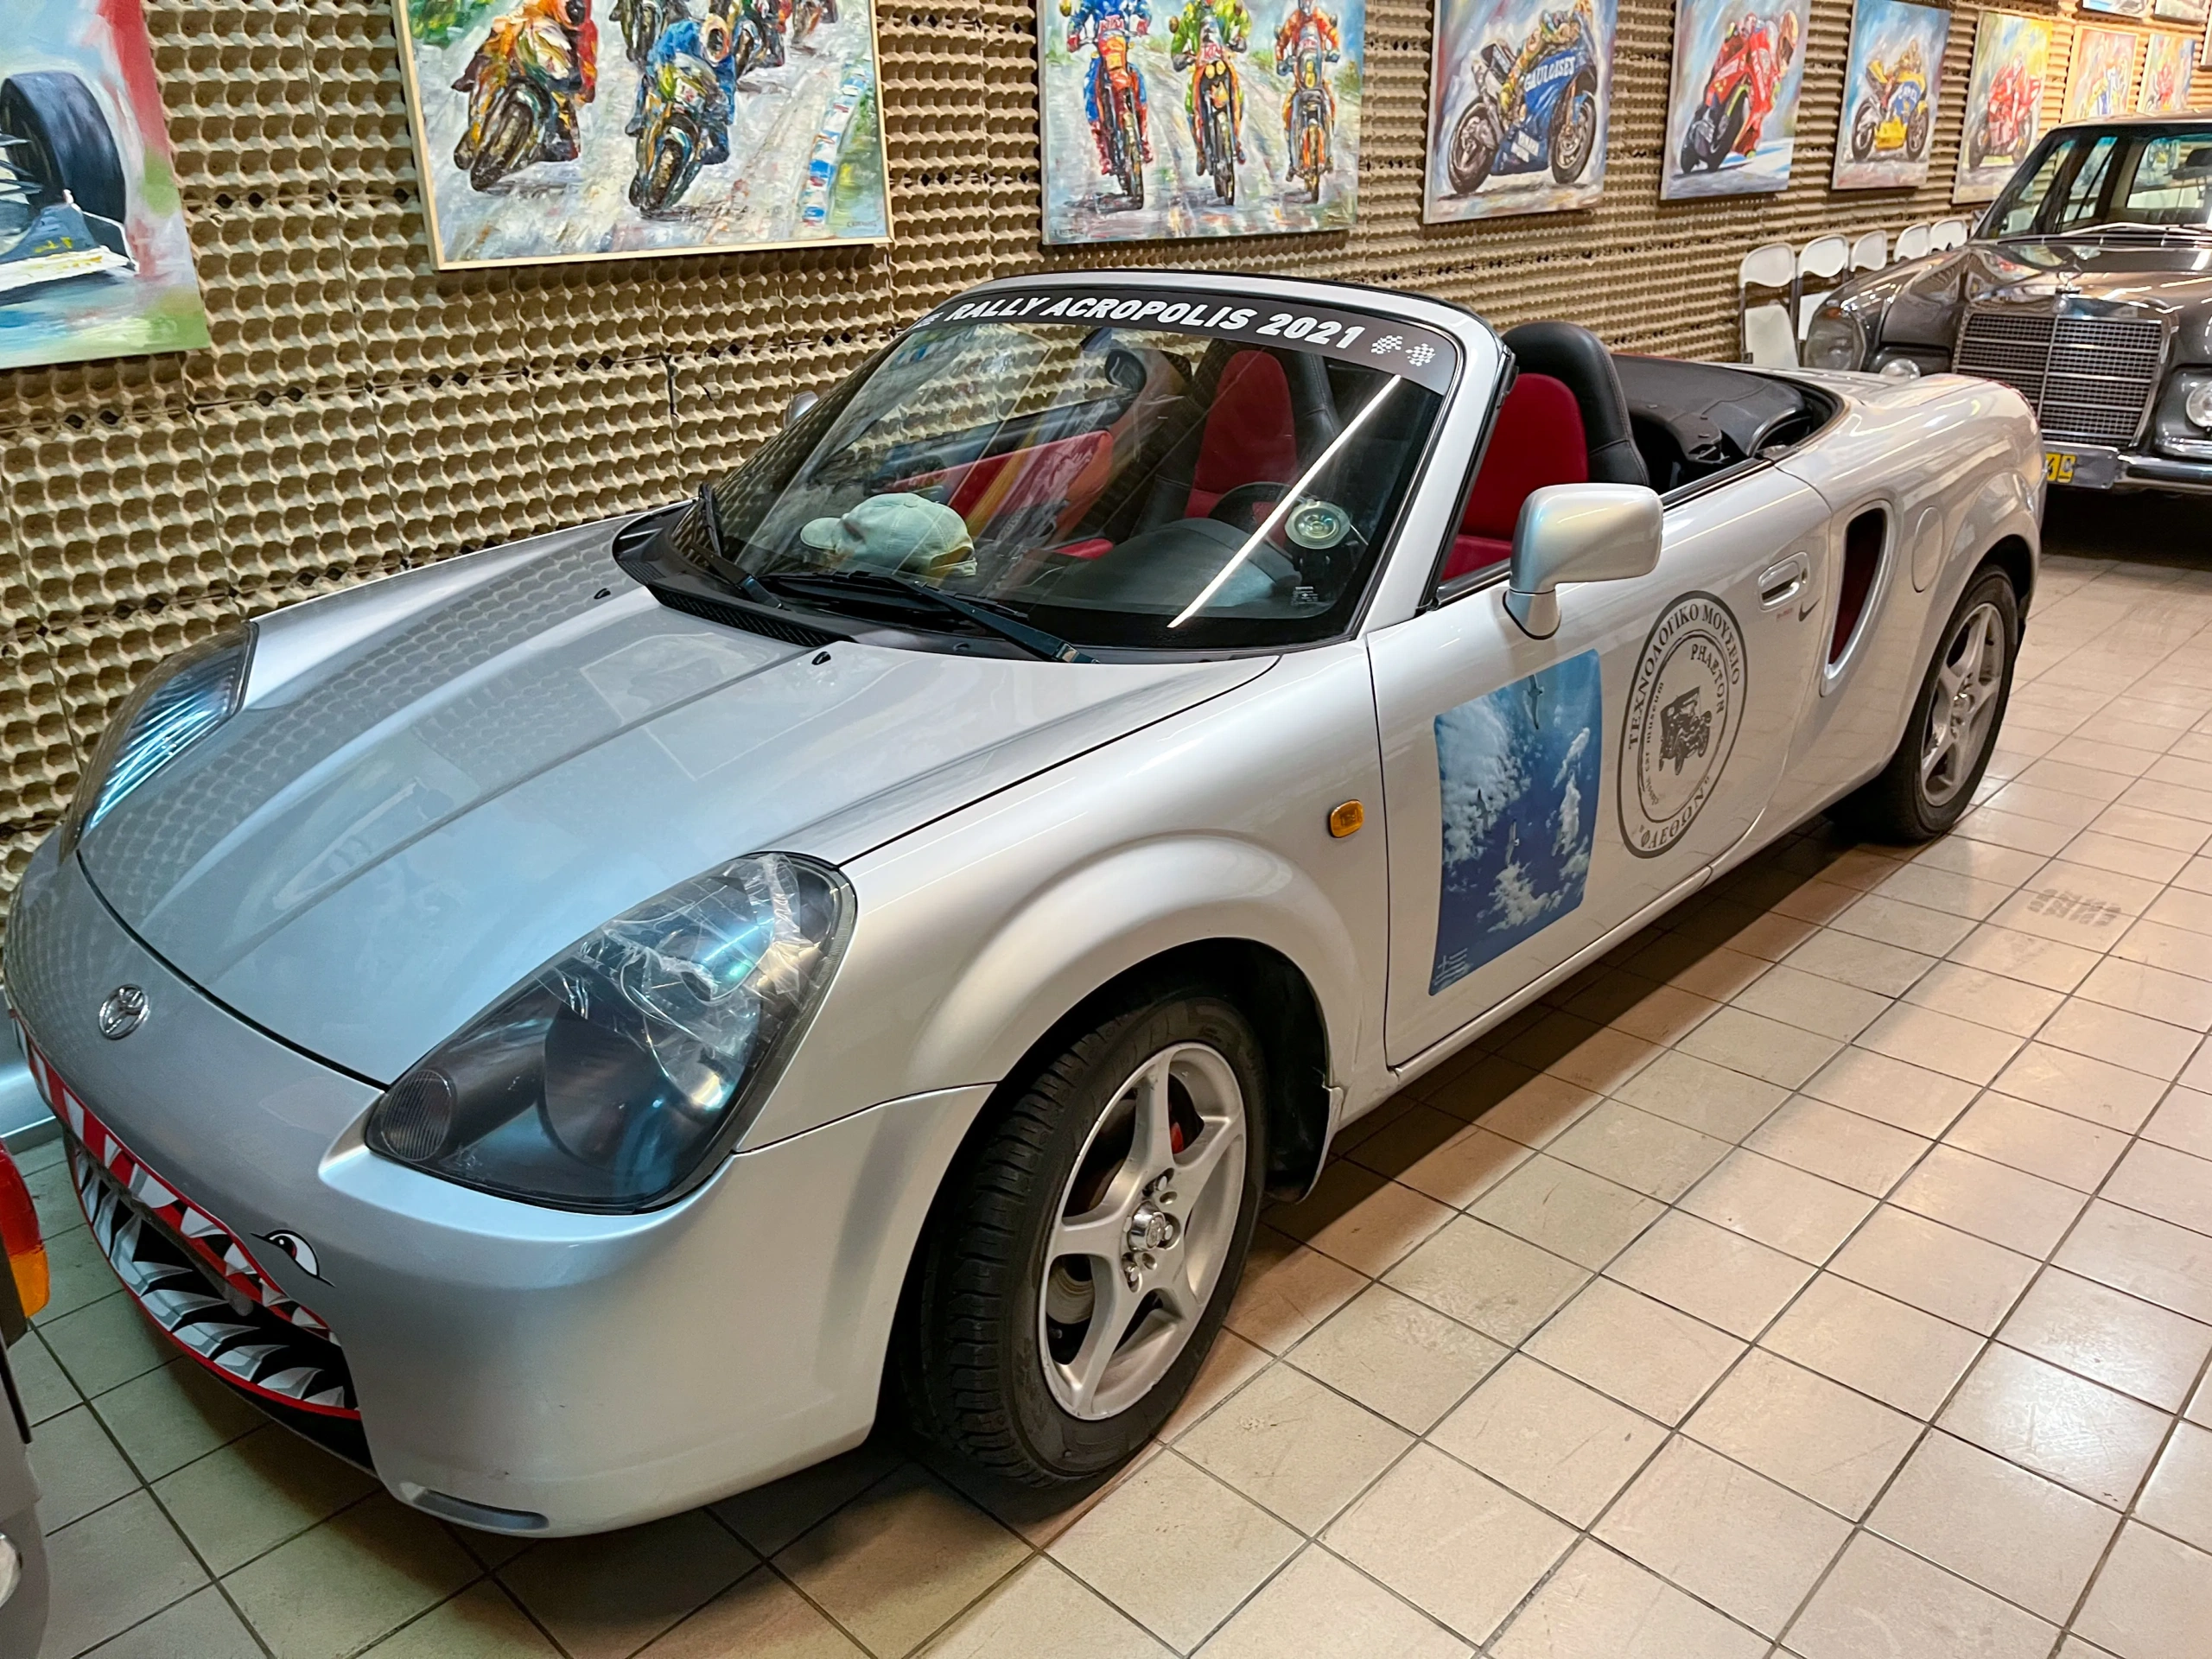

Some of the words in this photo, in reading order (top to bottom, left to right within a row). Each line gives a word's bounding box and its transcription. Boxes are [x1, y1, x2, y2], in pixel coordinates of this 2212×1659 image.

[944, 297, 1050, 321] RALLY
[1039, 296, 1258, 330] ACROPOLIS
[1256, 313, 1365, 349] 2021
[1629, 604, 1699, 749] ΤΕΧΝΟΛΟΓΙΚΟ
[1702, 605, 1740, 685] ΜΟΥΣΕΙΟ
[1646, 682, 1664, 744] museum
[1690, 643, 1726, 715] PHAETON
